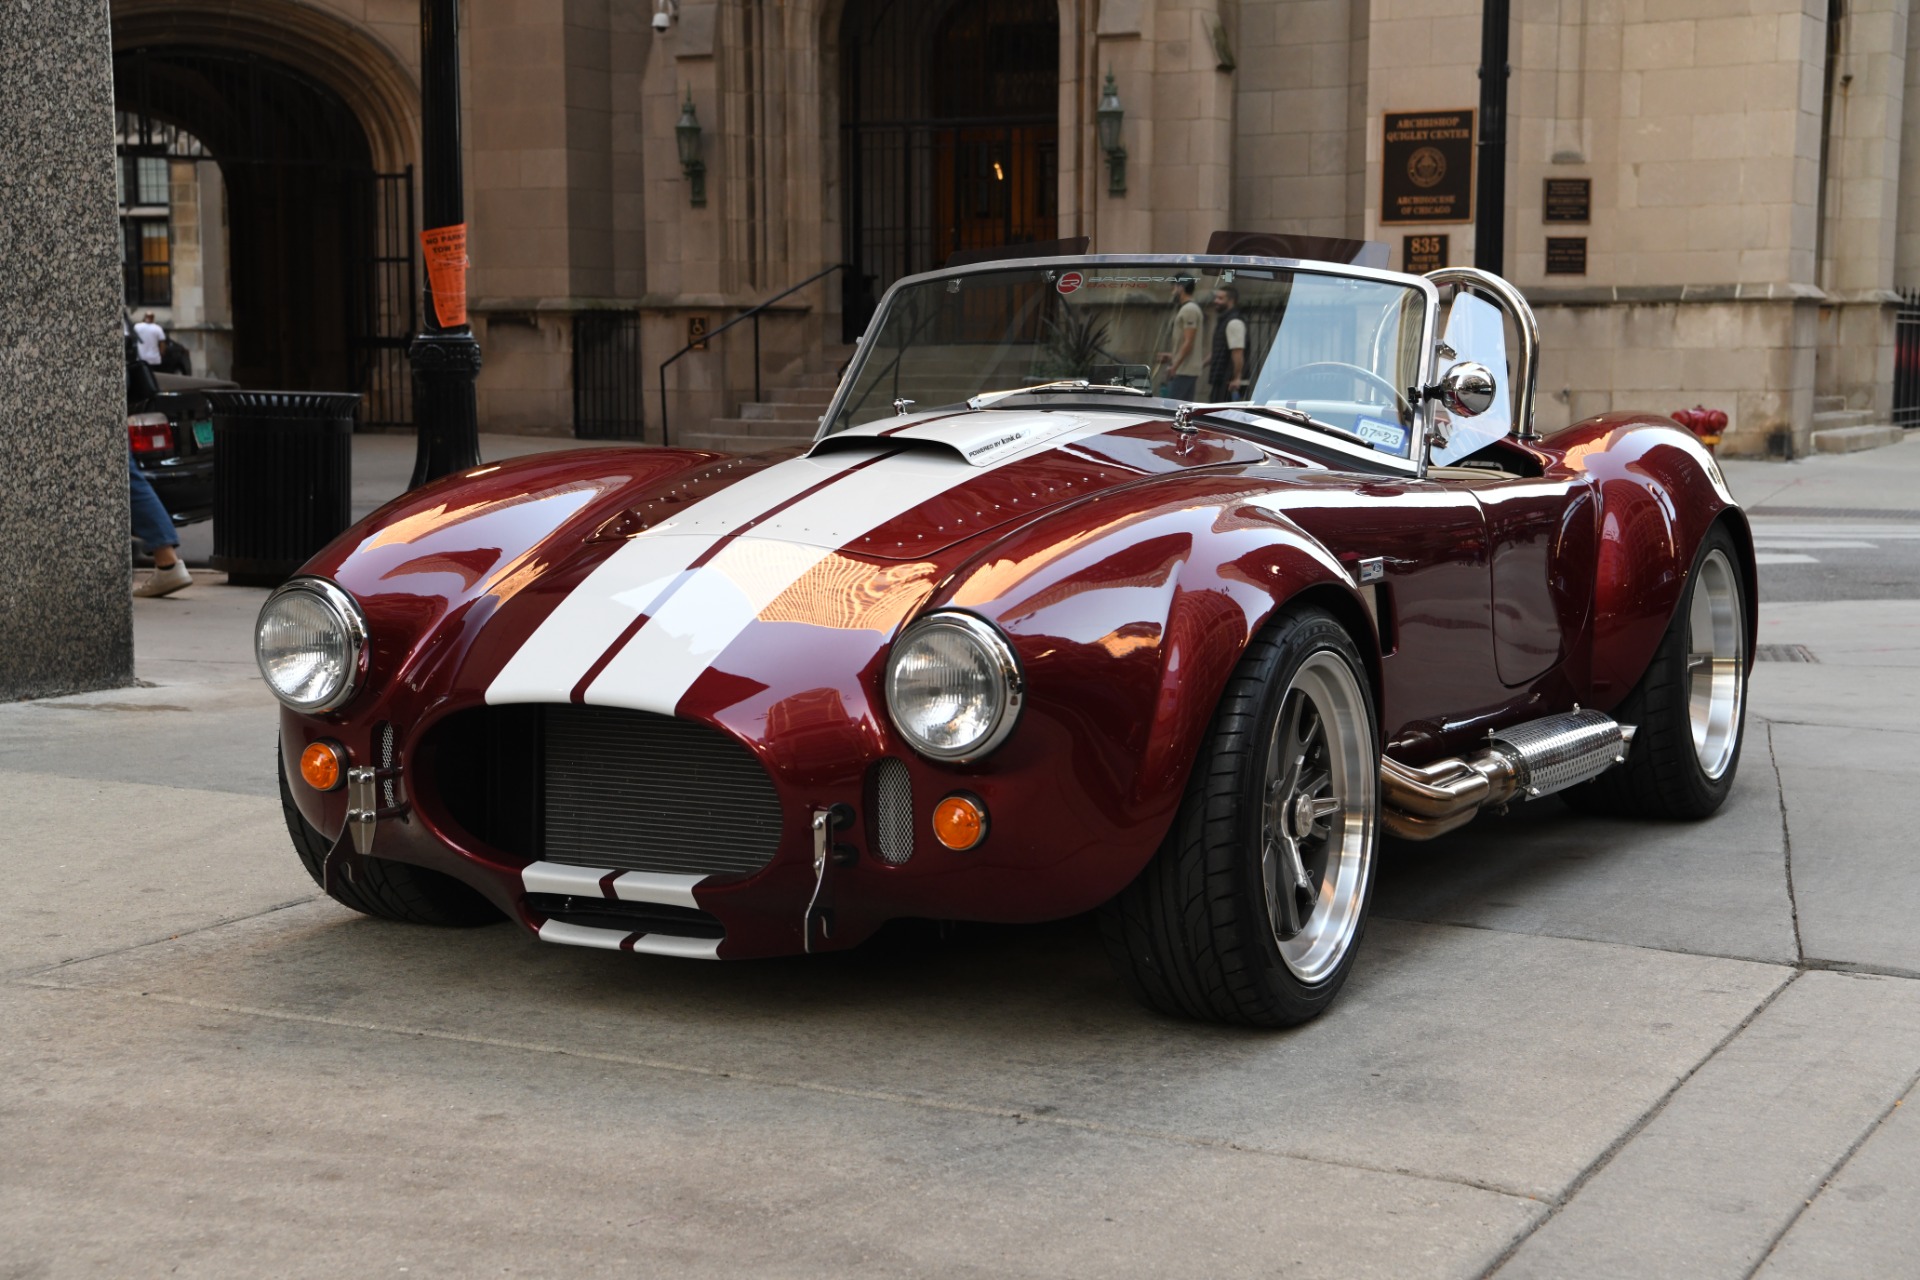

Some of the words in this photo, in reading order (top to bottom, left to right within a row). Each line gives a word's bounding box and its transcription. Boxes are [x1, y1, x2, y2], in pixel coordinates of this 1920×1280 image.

[1397, 118, 1459, 128] ARCHBISHOP
[1386, 131, 1428, 142] QUIGLEY
[1430, 129, 1470, 140] CENTER
[1397, 196, 1456, 205] ARCHDIOCESE
[1401, 206, 1413, 215] OF
[1413, 206, 1451, 214] CHICAGO
[426, 237, 439, 246] NO
[1411, 237, 1440, 254] 835
[1381, 431, 1399, 445] 23
[968, 443, 994, 457] POWERED
[993, 440, 1001, 448] BY
